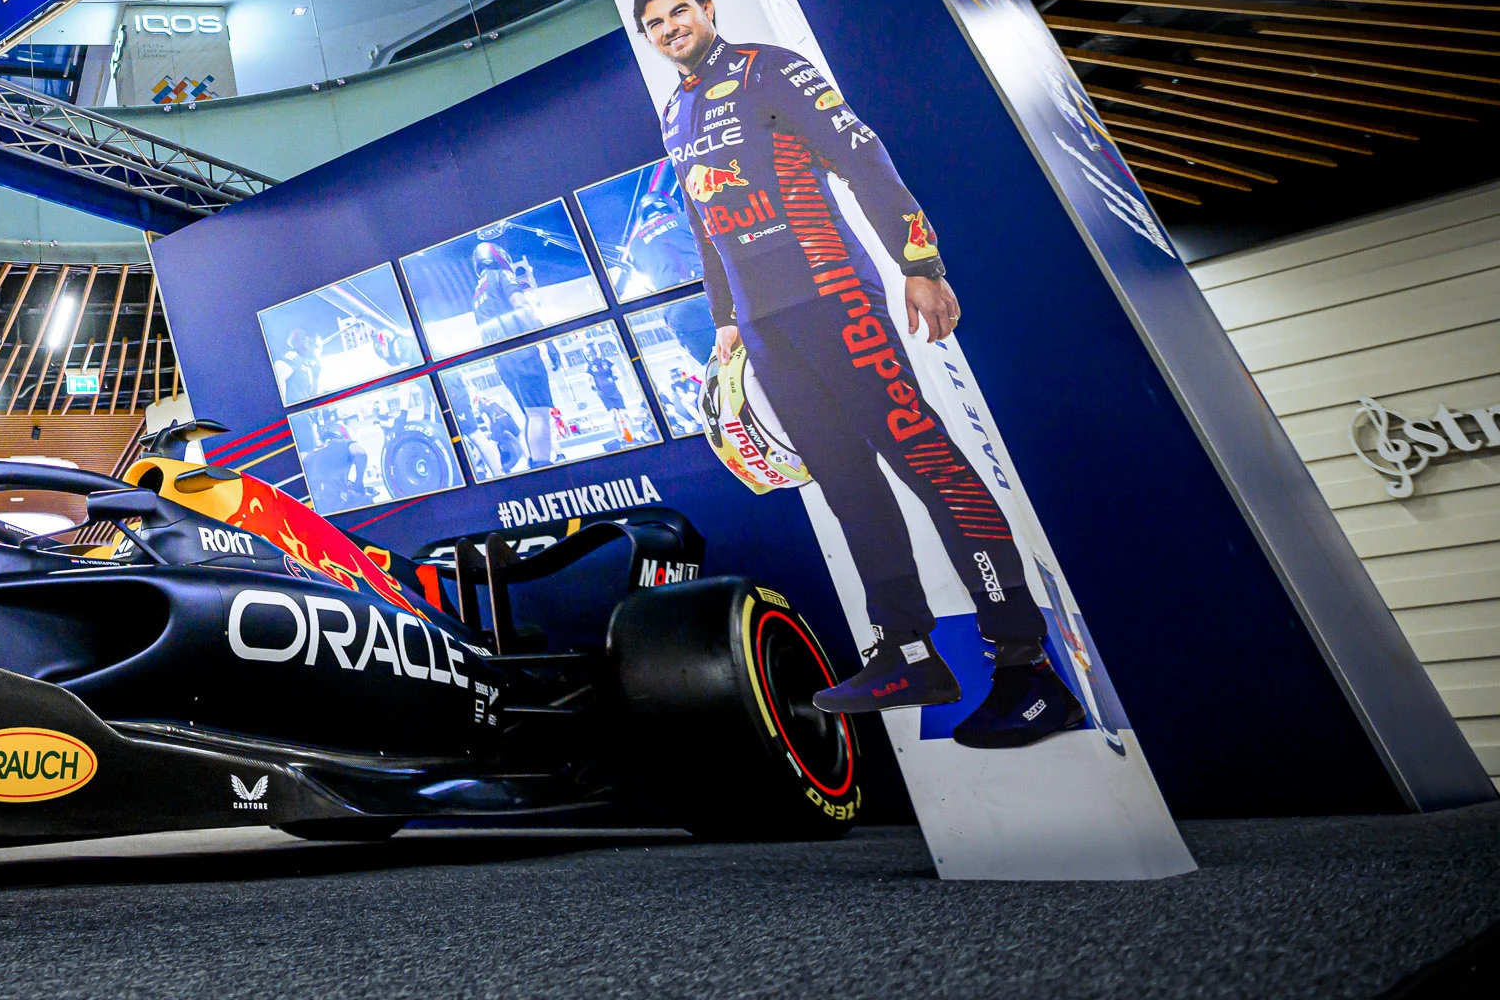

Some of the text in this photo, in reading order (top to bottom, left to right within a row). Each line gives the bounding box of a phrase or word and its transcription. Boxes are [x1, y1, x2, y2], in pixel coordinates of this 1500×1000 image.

[134, 14, 222, 36] IQOS
[706, 43, 726, 66] zoom
[705, 101, 736, 121] BYBIT
[703, 117, 740, 133] HONDA
[754, 224, 787, 238] CHECO
[944, 361, 1012, 491] DAJE TI
[498, 475, 662, 529] #DAJETIKRIIILA
[197, 526, 254, 555] ROKT
[638, 558, 684, 587] Mobil
[973, 551, 1004, 602] sparco
[228, 589, 469, 689] ORACLE
[1022, 699, 1045, 720] sparco
[233, 801, 269, 810] CASTORE
[805, 786, 855, 820] ZERO
